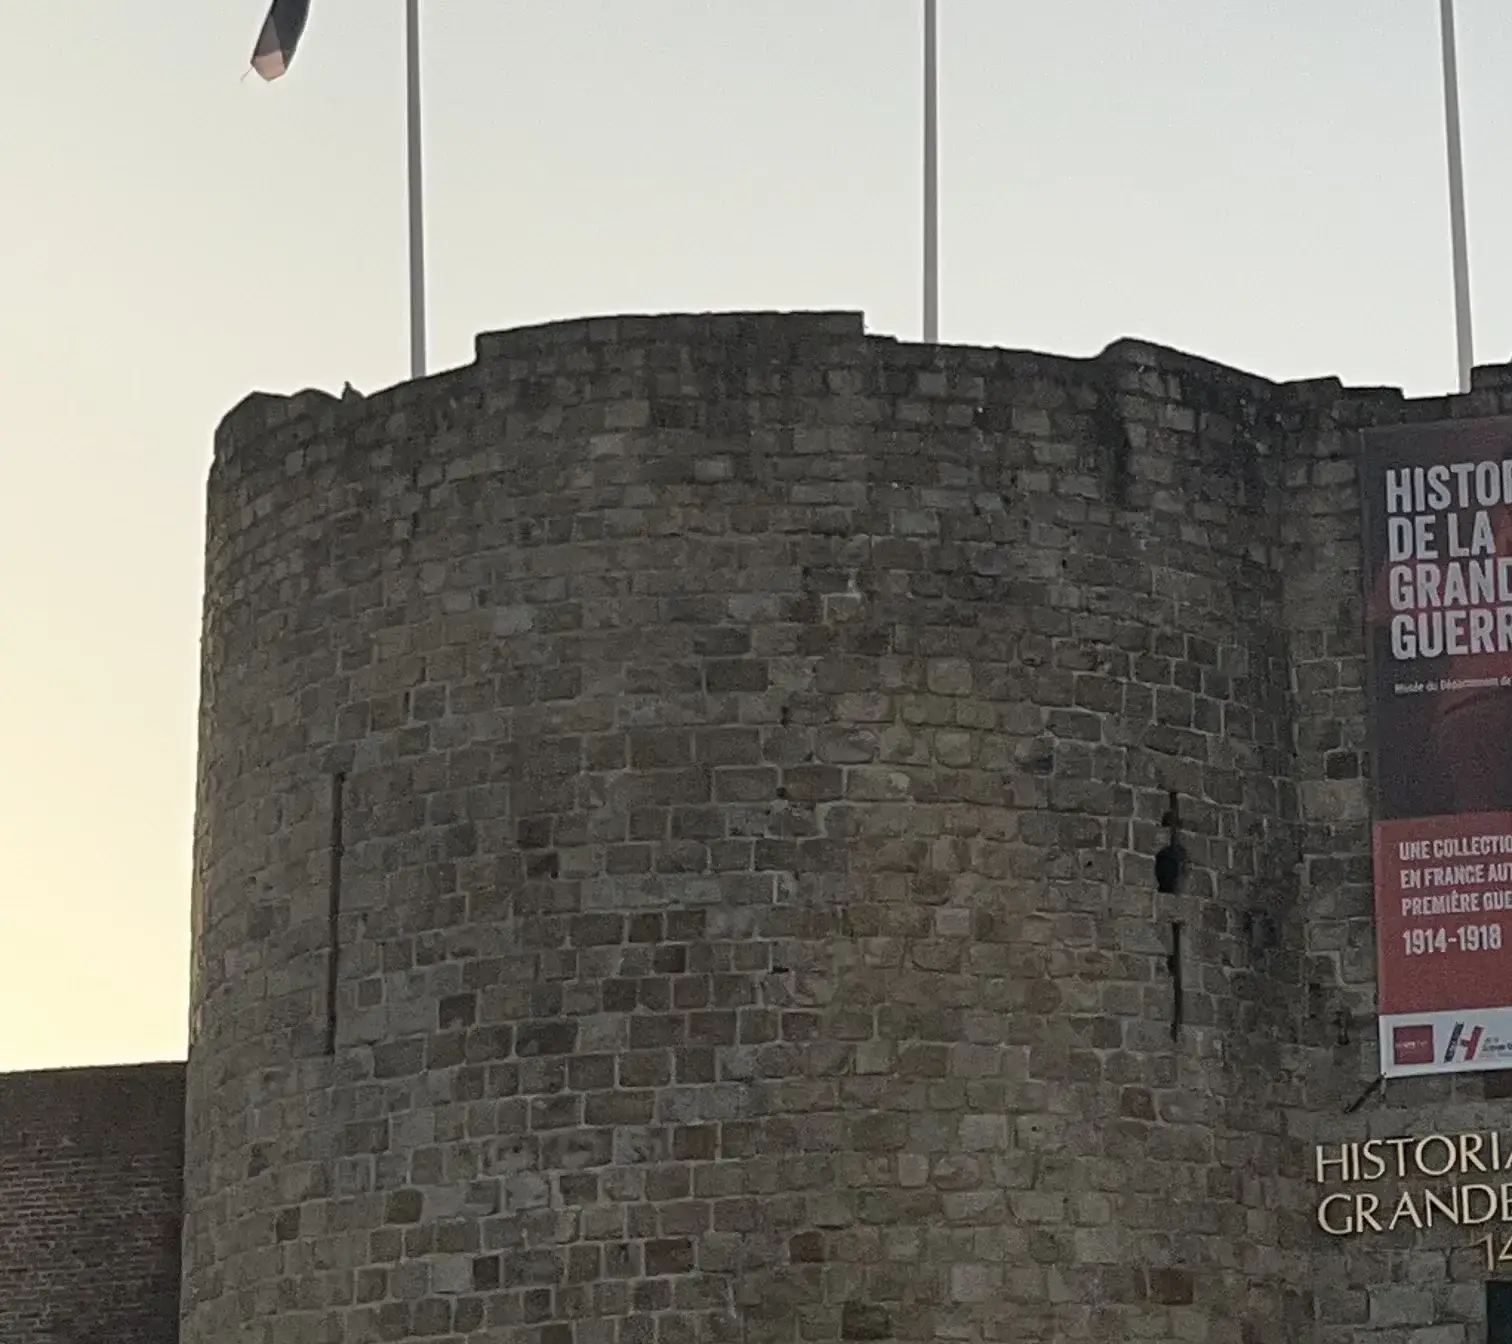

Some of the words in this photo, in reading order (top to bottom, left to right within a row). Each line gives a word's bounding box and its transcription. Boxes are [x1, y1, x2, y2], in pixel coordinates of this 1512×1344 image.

[1388, 515, 1438, 562] DE
[1447, 510, 1496, 557] LA
[1400, 840, 1429, 861] UNE
[1400, 868, 1421, 889] EN
[1424, 863, 1485, 886] FRANCE
[1401, 888, 1480, 916] PREMIÈRE
[1403, 923, 1502, 956] 1914-1918
